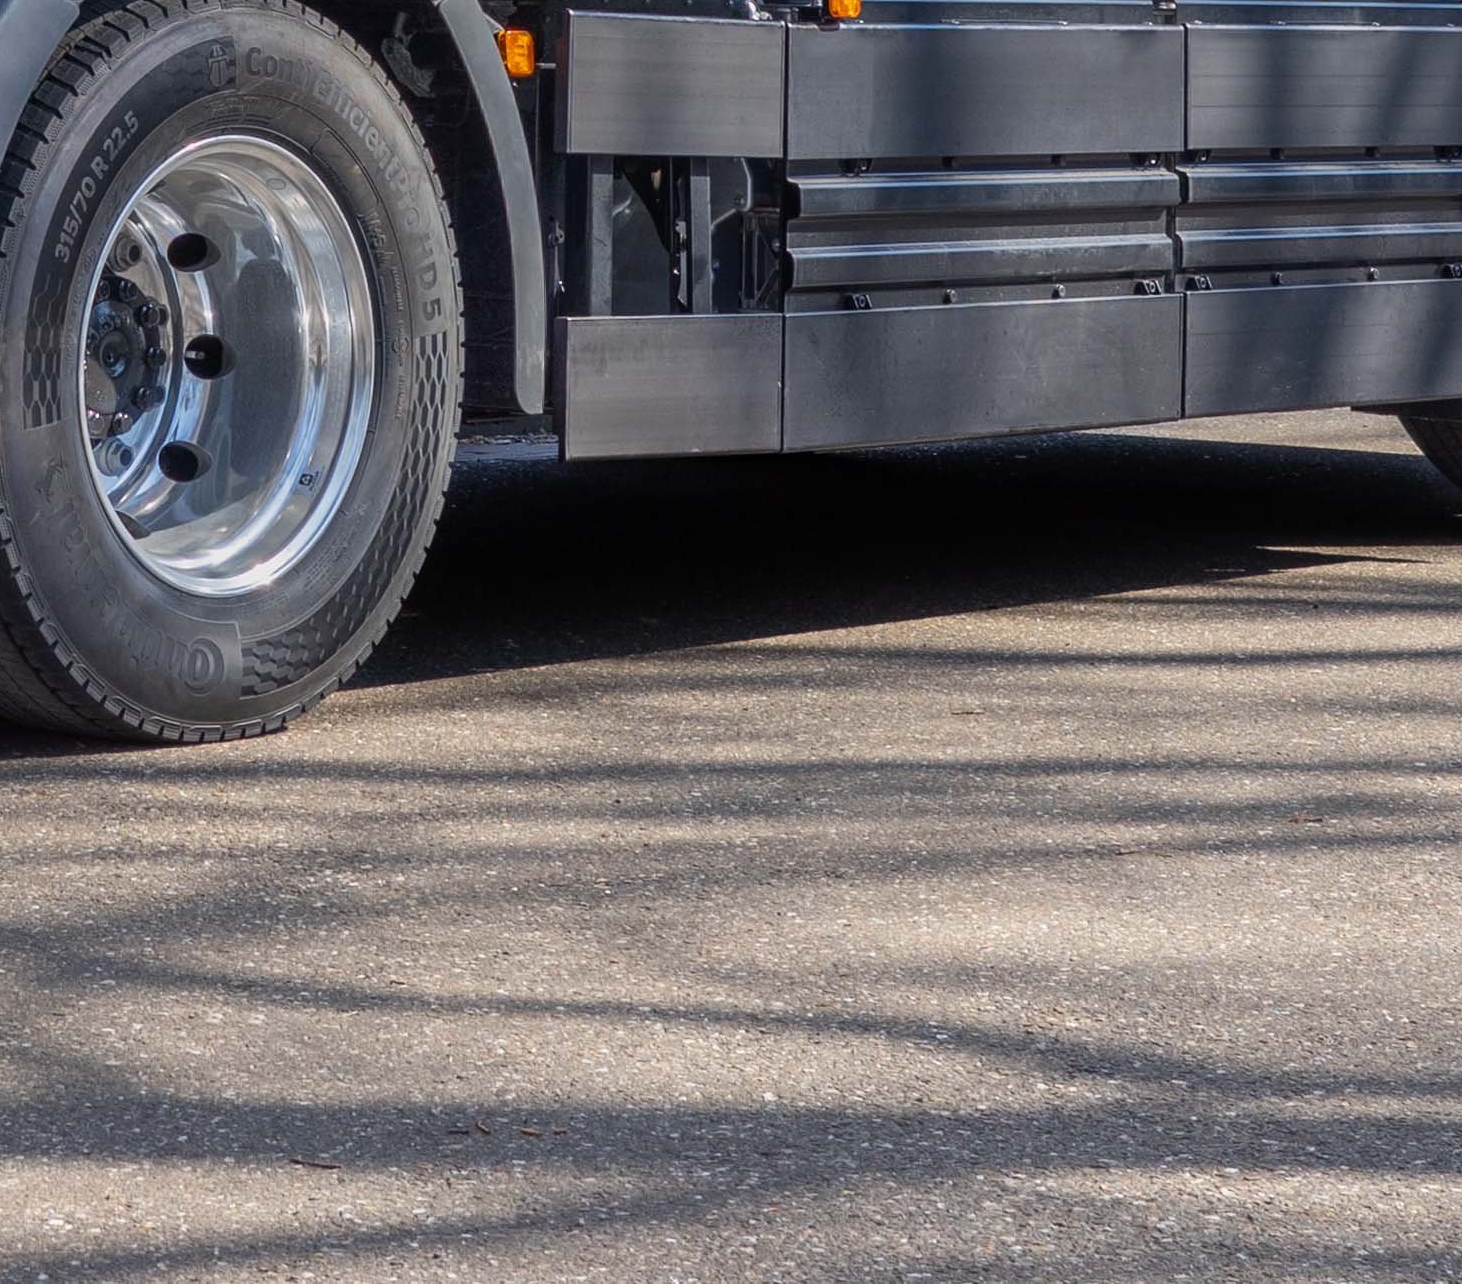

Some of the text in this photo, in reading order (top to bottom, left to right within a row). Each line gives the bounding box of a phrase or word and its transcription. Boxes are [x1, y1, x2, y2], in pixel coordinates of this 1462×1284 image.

[55, 110, 139, 263] 315/70 R 22.5
[424, 297, 442, 322] 5
